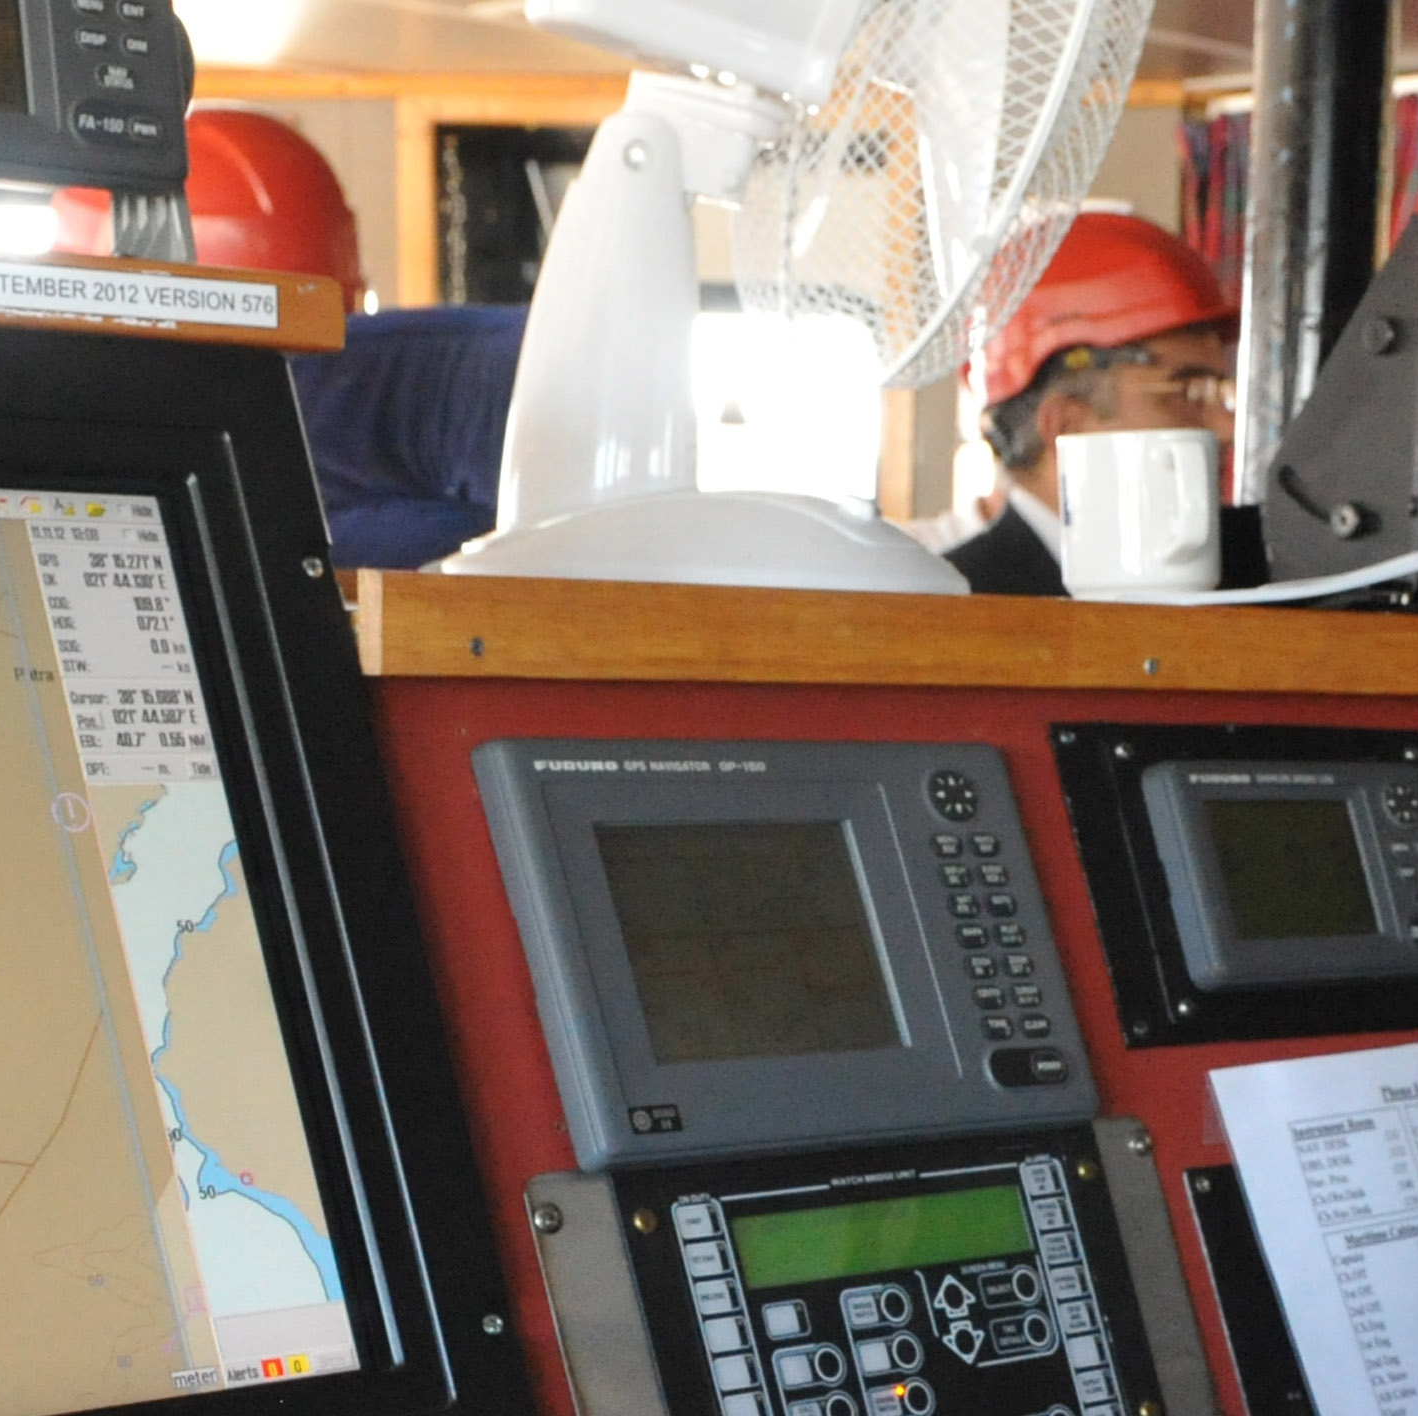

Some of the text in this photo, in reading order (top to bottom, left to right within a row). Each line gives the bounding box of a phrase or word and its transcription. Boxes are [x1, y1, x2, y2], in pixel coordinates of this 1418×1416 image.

[92, 278, 140, 306] 2012
[144, 283, 237, 314] VERSION
[241, 290, 277, 317] 576
[173, 1364, 260, 1388] meter Alerts
